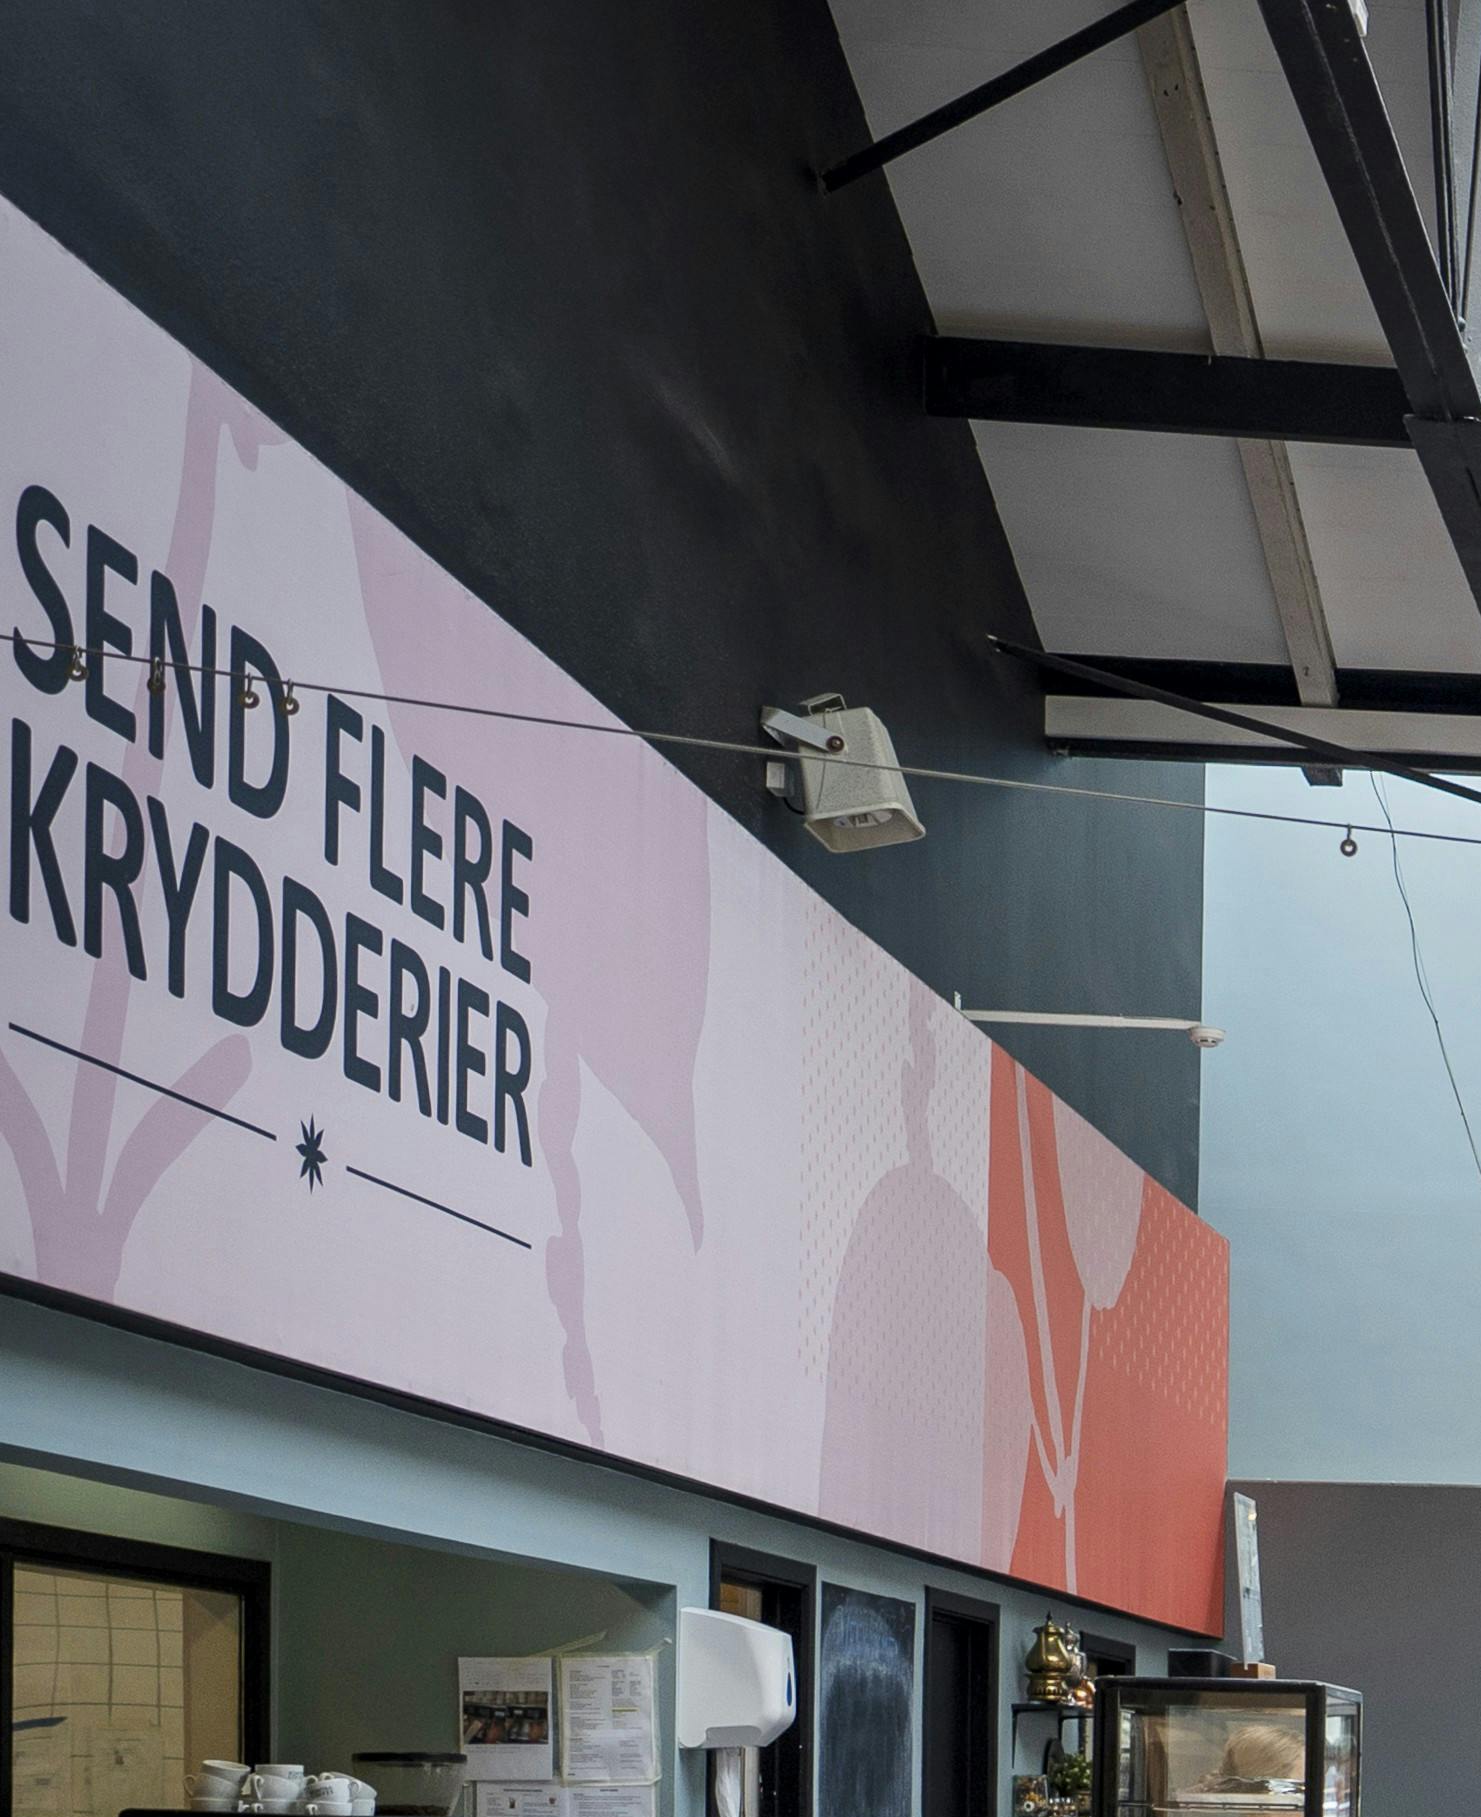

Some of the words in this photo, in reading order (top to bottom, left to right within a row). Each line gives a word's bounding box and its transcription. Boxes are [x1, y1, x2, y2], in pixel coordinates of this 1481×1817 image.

[9, 716, 535, 1168] KRYDDERIER
[13, 482, 290, 822] SEND
[323, 692, 537, 987] FLERE
